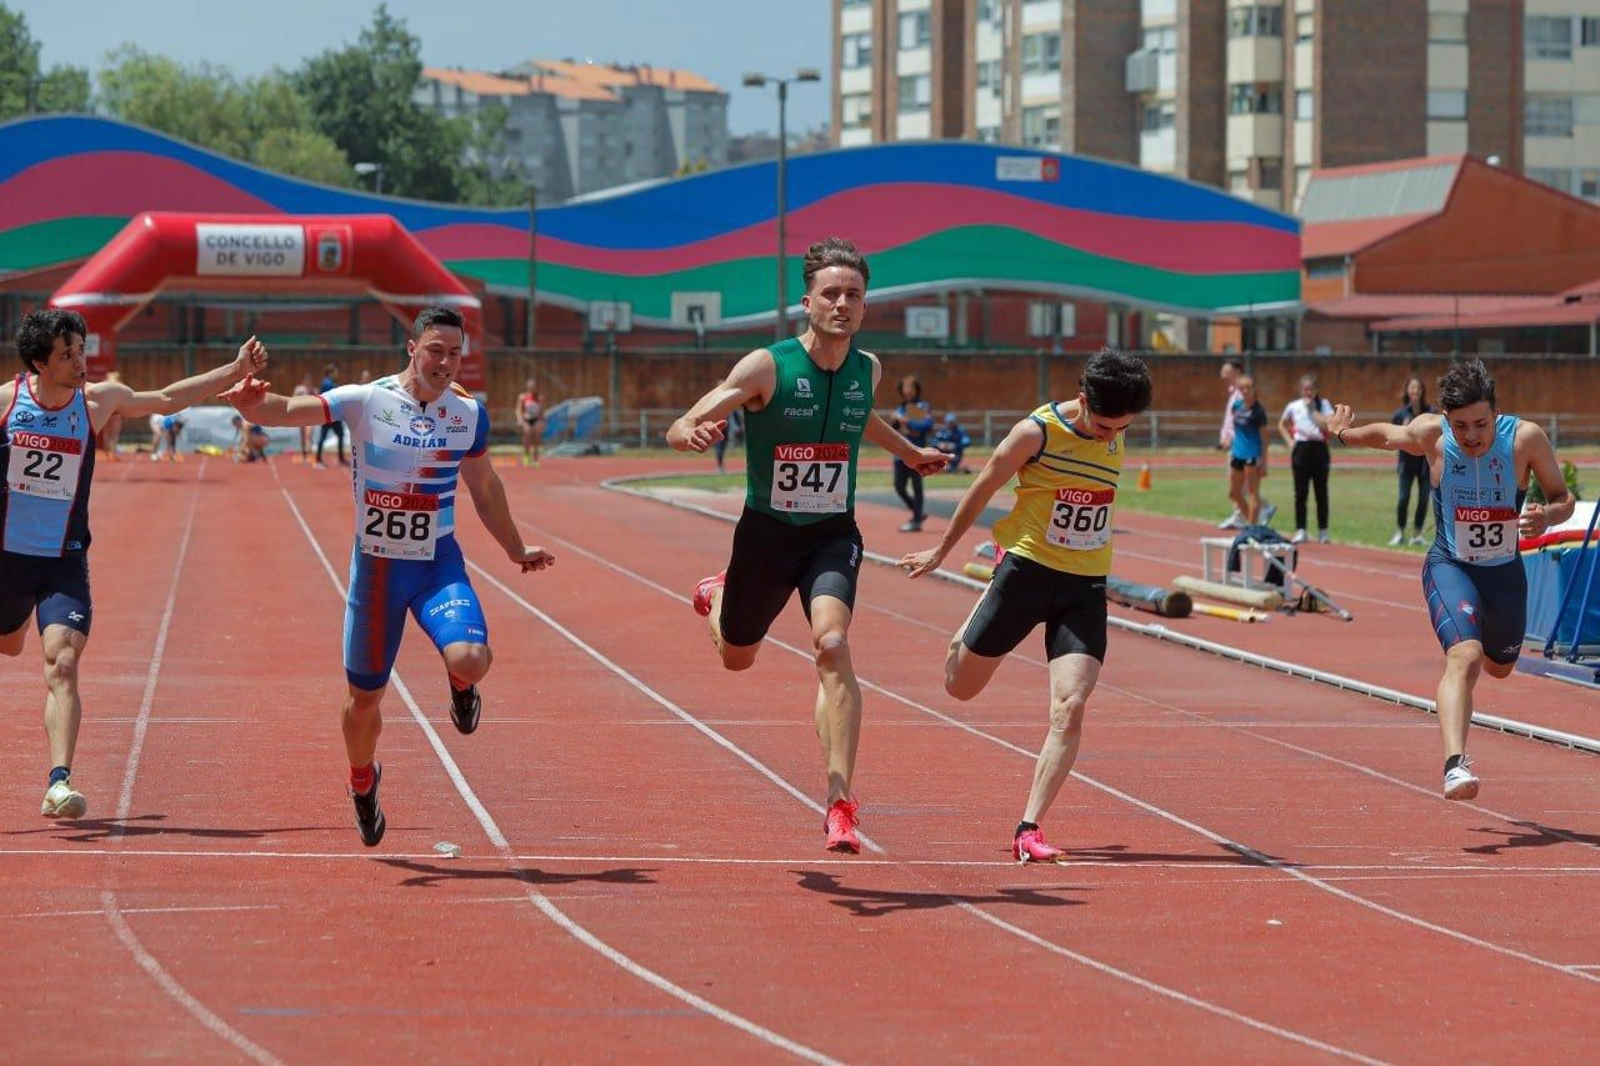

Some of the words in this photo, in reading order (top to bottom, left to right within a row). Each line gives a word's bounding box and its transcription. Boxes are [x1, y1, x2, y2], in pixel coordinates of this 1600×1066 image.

[206, 235, 296, 250] CONCELLO
[217, 252, 238, 265] DE
[244, 252, 285, 266] VIGO
[23, 450, 63, 481] 22
[778, 463, 842, 493] 347
[1059, 488, 1093, 503] VIGO
[365, 507, 431, 541] 268
[1053, 503, 1108, 532] 360
[1457, 509, 1490, 521] VIGO
[1469, 523, 1504, 548] 33
